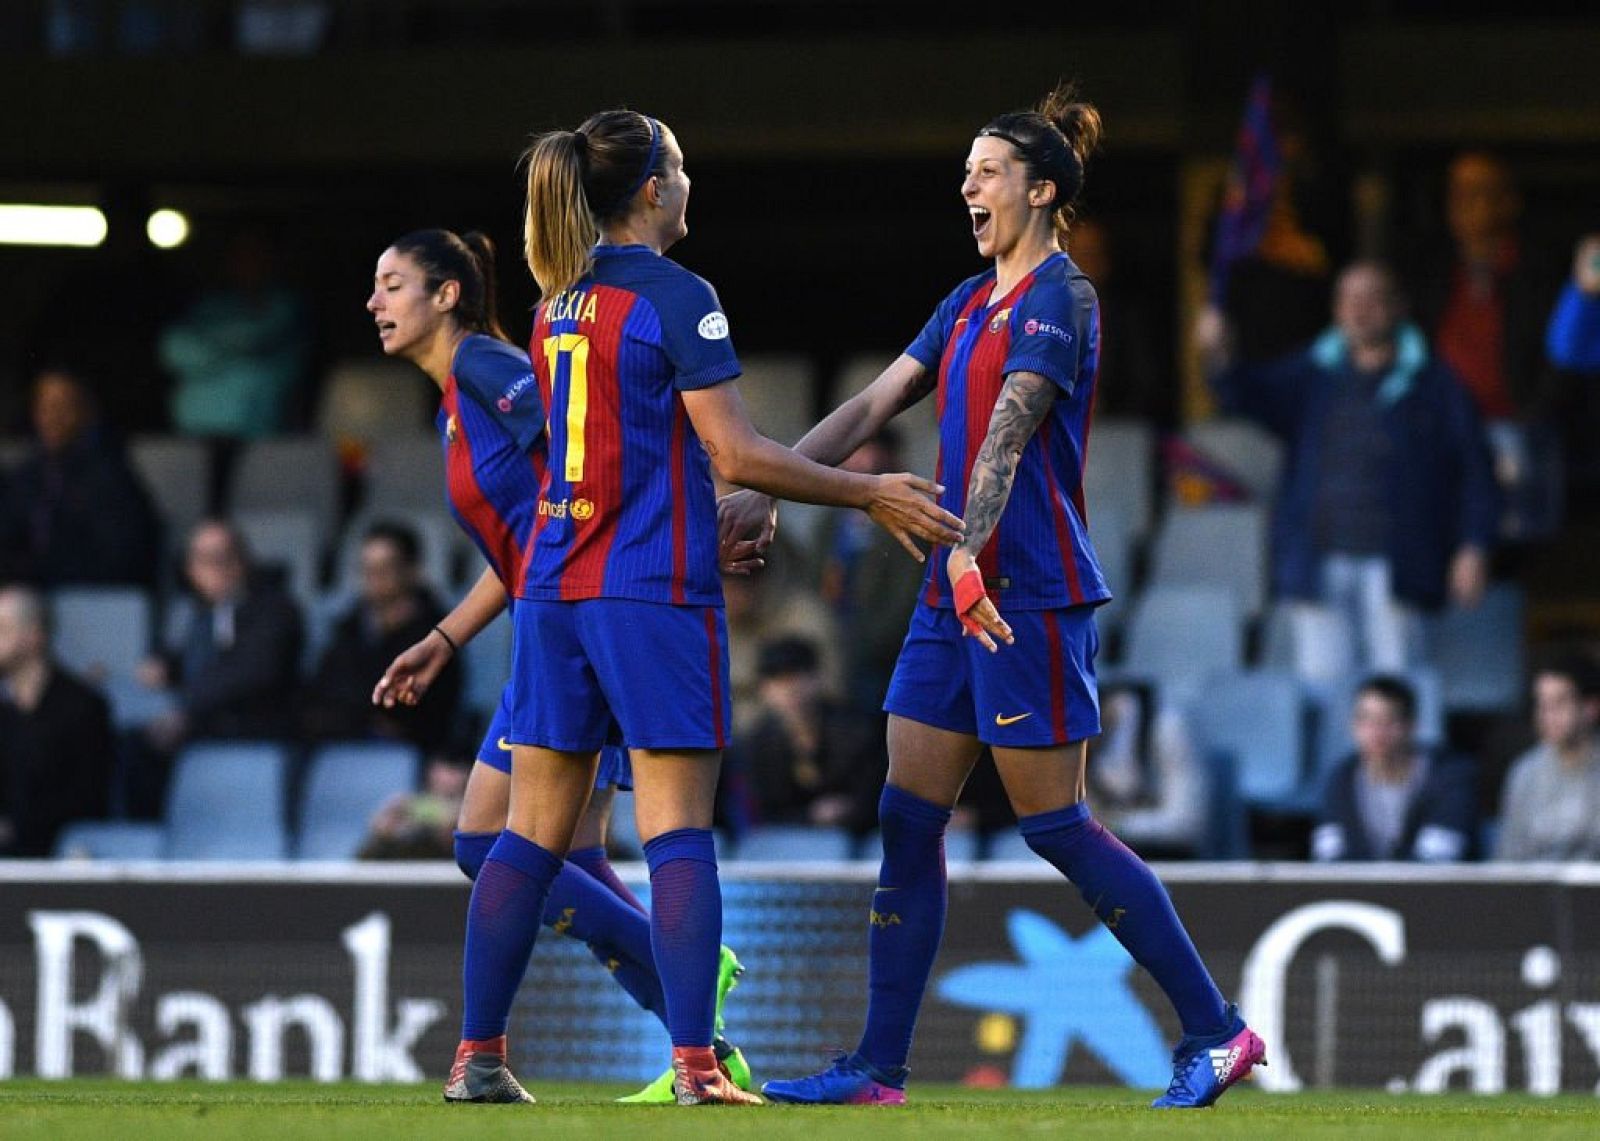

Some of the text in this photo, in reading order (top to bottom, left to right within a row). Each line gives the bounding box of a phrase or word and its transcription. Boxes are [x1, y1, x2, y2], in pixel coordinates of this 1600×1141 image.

[543, 290, 598, 323] ALEXIA
[1039, 323, 1072, 343] RESPECT
[0, 908, 446, 1081] Bank
[1219, 1045, 1242, 1084] adidas
